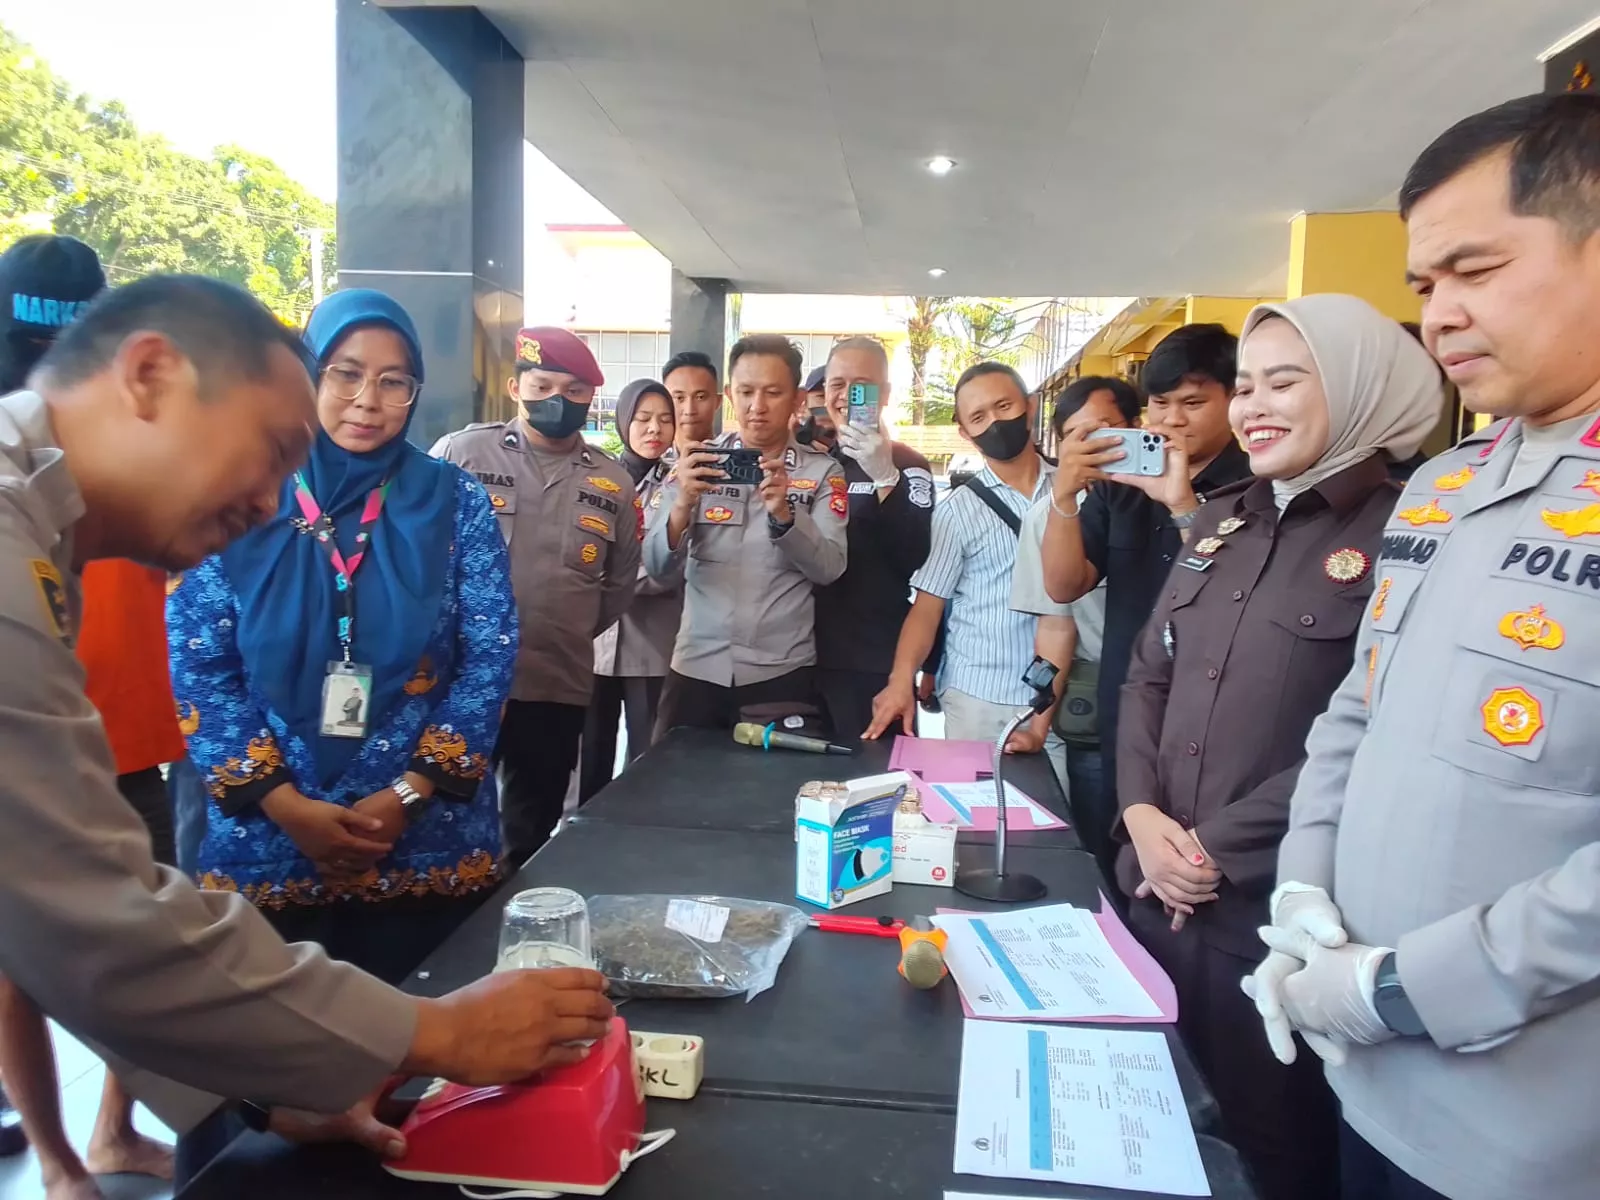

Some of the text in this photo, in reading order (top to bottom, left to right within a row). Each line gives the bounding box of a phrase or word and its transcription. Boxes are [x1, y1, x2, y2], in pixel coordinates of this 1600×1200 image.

[476, 472, 514, 487] IMAS
[576, 490, 618, 515] POLRI
[1501, 543, 1600, 590] POLR
[833, 829, 851, 839] FACE
[851, 824, 870, 835] MASK
